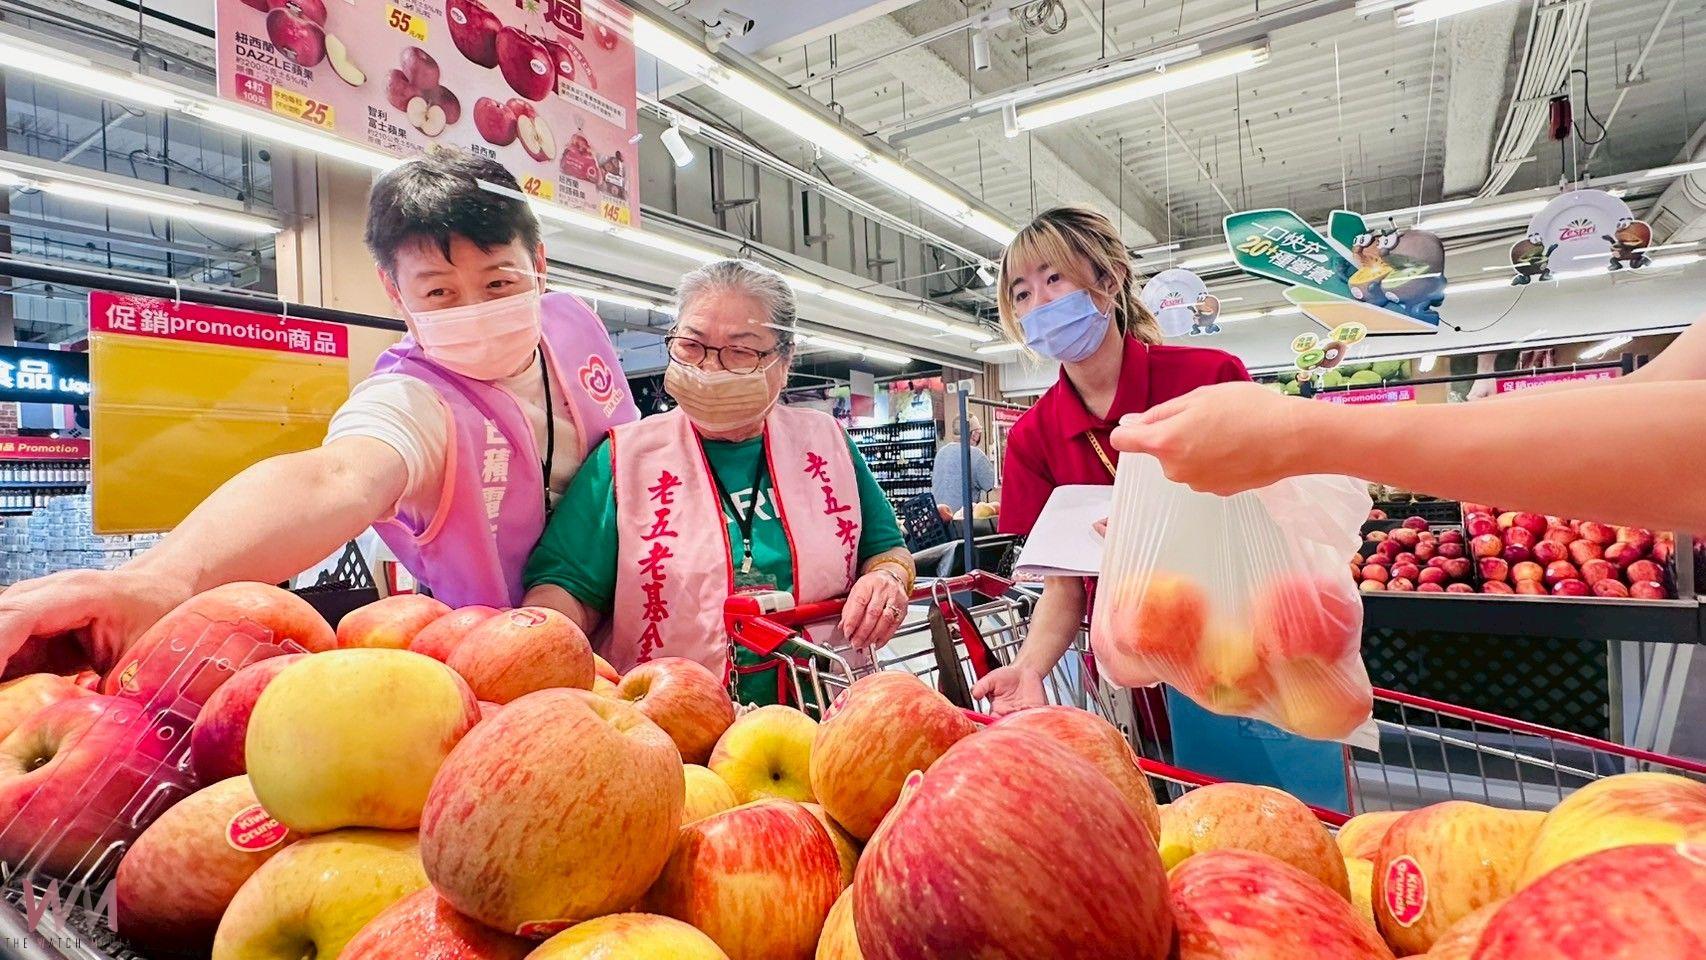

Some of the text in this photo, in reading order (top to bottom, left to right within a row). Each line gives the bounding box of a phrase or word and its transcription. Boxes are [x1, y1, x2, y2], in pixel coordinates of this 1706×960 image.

[389, 9, 411, 32] 55
[235, 31, 275, 54] 紐西蘭
[236, 44, 314, 81] DAZZLE蘋果
[301, 99, 329, 125] 25
[368, 105, 388, 121] 智利
[368, 117, 408, 139] 富士蘋果
[524, 176, 541, 196] 42
[603, 203, 621, 222] 145
[1250, 221, 1328, 254] 一口快充
[1559, 224, 1597, 241] Zespri
[105, 303, 337, 354] 促銷promotion商品
[18, 443, 79, 453] Promotion
[636, 470, 683, 664] 老五老基金
[237, 818, 280, 845] Crunc
[1405, 871, 1418, 907] Kiwi
